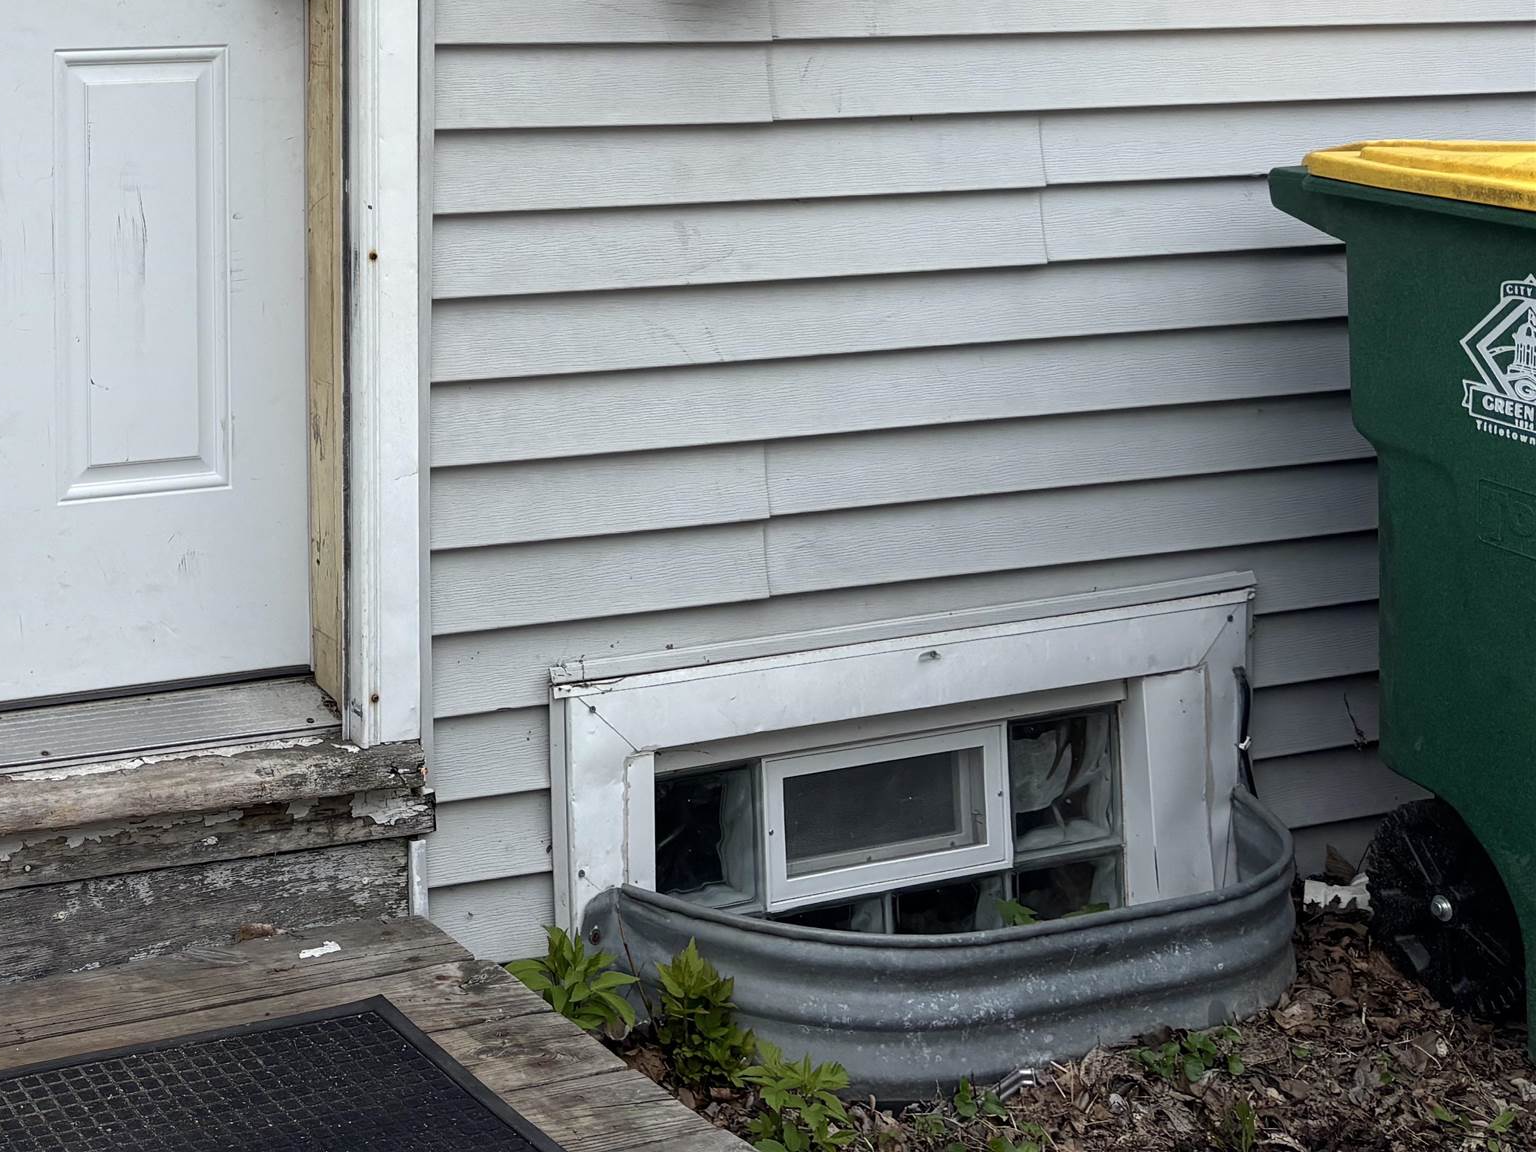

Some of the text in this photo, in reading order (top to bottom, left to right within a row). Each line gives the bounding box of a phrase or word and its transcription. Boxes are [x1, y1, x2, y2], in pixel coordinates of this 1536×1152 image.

[1506, 284, 1532, 297] CITY
[1482, 394, 1534, 422] GREEN
[1475, 419, 1536, 447] Titletown
